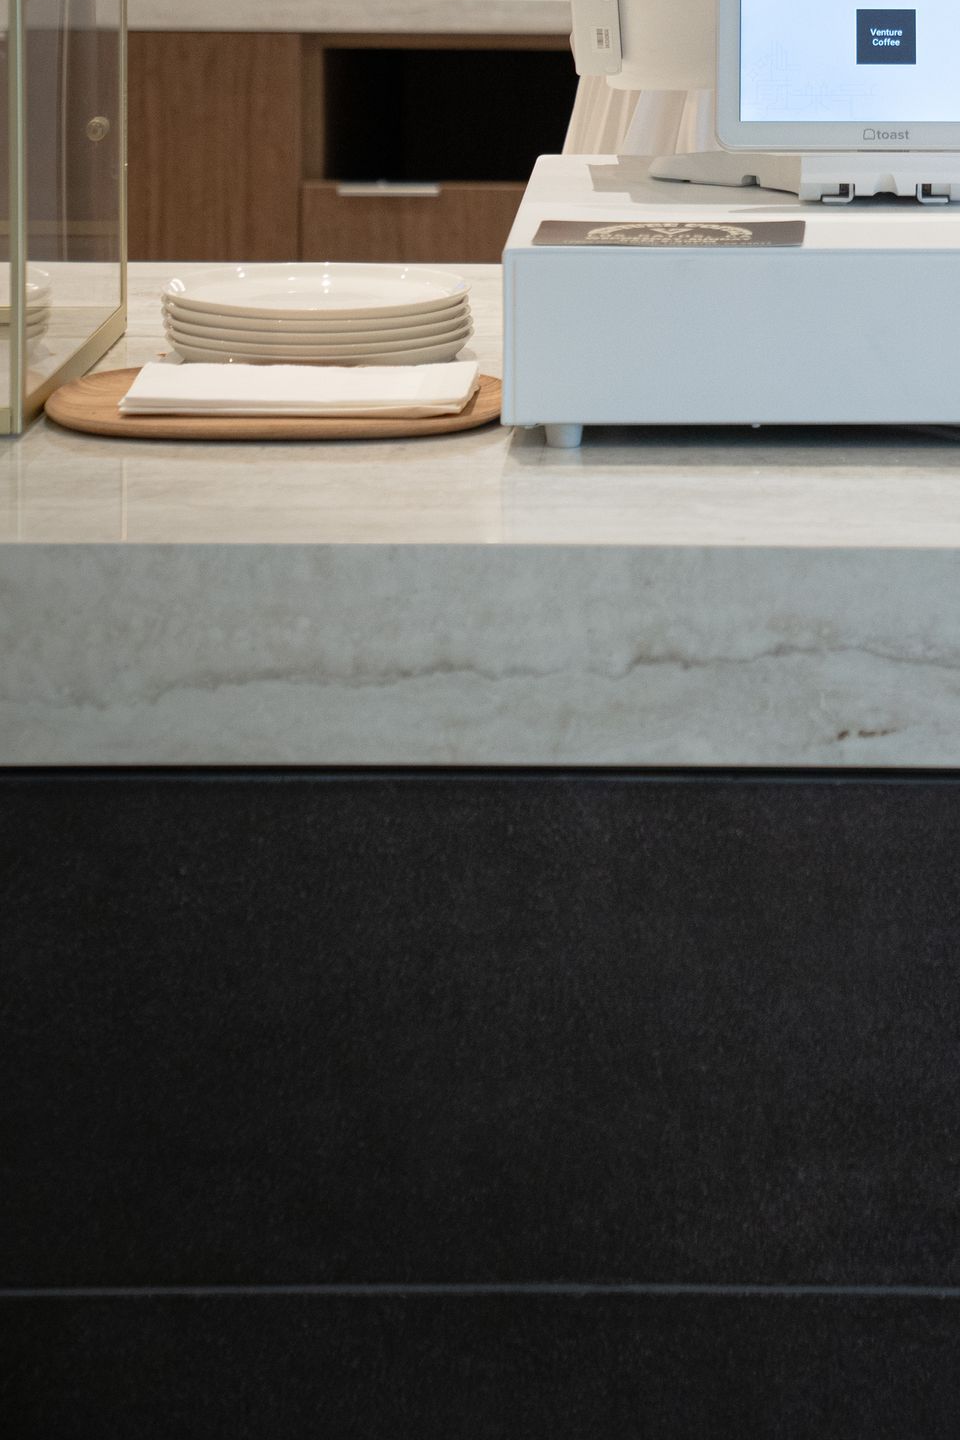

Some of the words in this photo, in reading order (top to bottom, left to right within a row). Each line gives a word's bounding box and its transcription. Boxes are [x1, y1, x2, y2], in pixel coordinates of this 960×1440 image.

[870, 28, 903, 37] Venture
[872, 38, 901, 47] Coffee
[876, 129, 909, 140] toast
